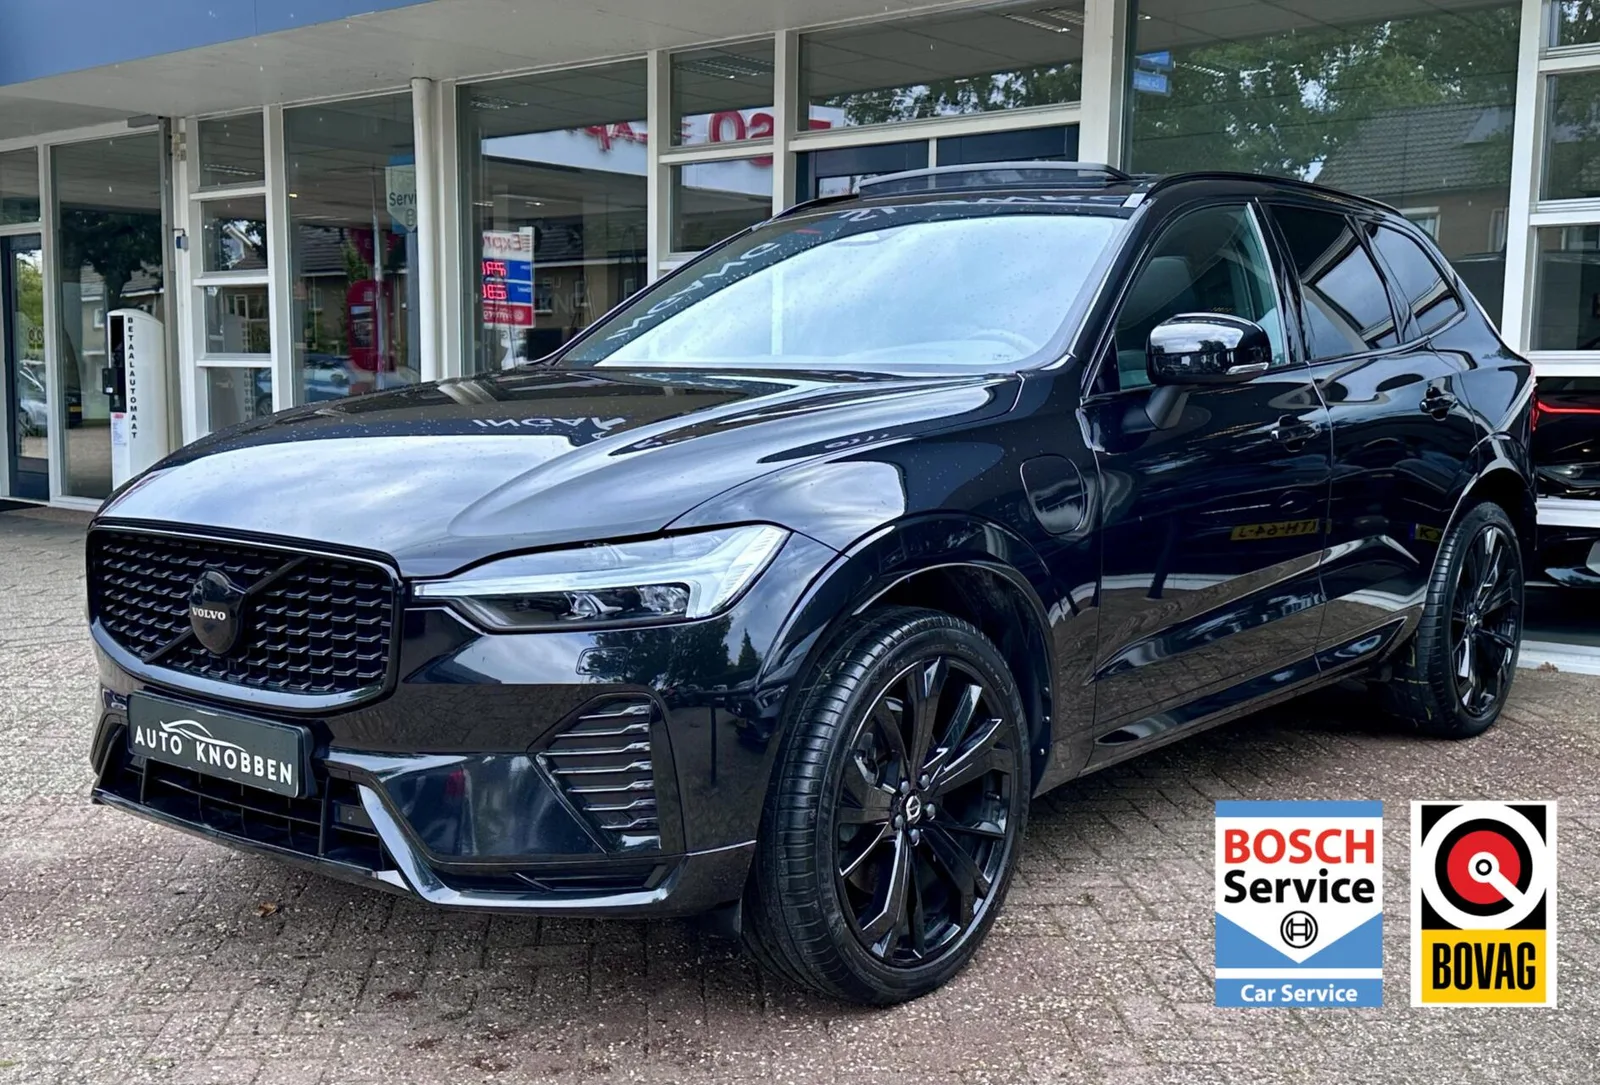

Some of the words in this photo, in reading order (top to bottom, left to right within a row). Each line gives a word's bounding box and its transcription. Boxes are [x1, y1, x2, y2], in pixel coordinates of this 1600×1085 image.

[127, 317, 138, 439] BETAALAUTOMAAT
[191, 606, 226, 621] VOLVO
[134, 725, 183, 755] AUTO
[195, 741, 293, 785] KNOBBEN
